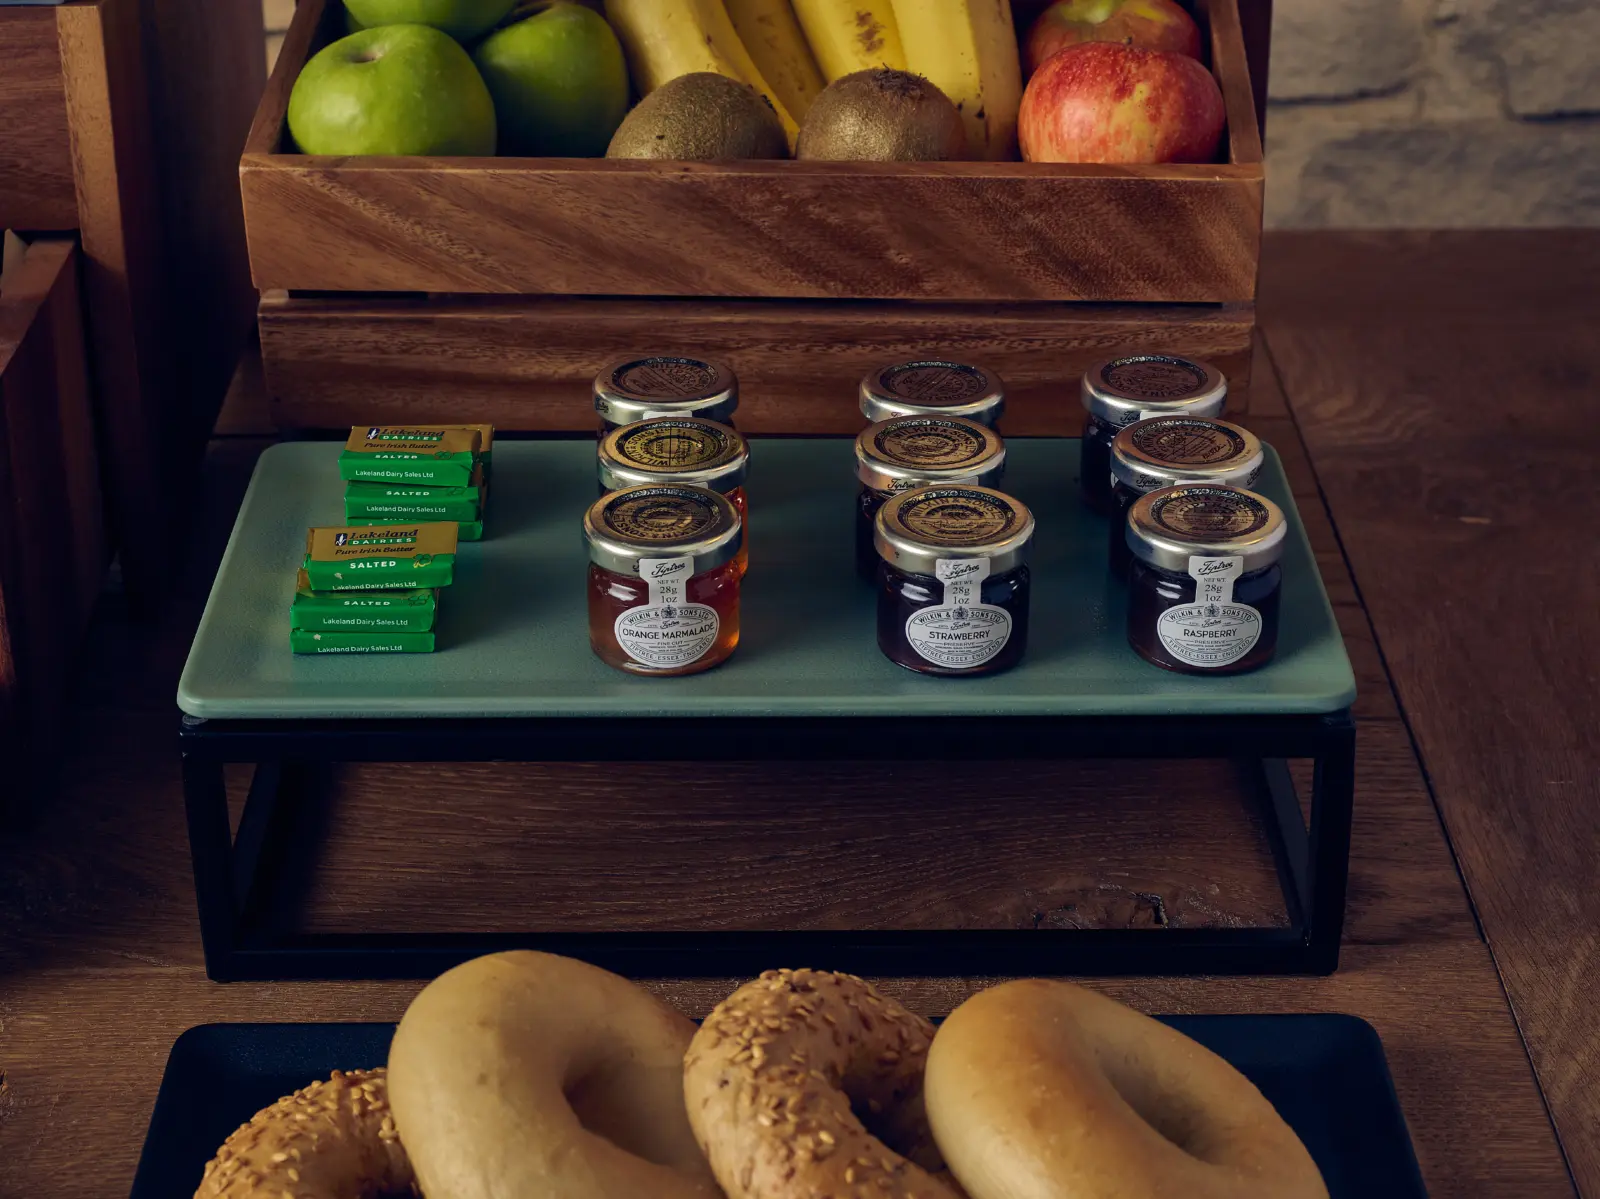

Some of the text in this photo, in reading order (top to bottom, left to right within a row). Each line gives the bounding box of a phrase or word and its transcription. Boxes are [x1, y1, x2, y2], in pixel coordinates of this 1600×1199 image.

[381, 428, 446, 437] Lakeland
[386, 470, 403, 478] Dairy
[350, 529, 418, 539] Lakeland
[350, 561, 396, 569] SALTED
[660, 586, 678, 595] 28g
[952, 586, 970, 596] 28g
[1205, 584, 1222, 594] 28g
[661, 595, 678, 604] 1oz
[953, 596, 970, 604] 1oz
[1205, 594, 1222, 602] 1oz
[628, 612, 651, 624] WILKIN
[918, 612, 942, 623] WILKIN
[971, 611, 989, 619] SONS
[989, 613, 1001, 622] LTD
[1169, 609, 1193, 620] WILKIN
[1222, 609, 1240, 617] SONS
[1241, 611, 1252, 620] LTD
[356, 618, 375, 626] Dairy
[622, 622, 715, 640] ORANGE MARMALADE
[929, 630, 991, 641] STRAWBERRY
[1183, 628, 1238, 639] RASPBERRY
